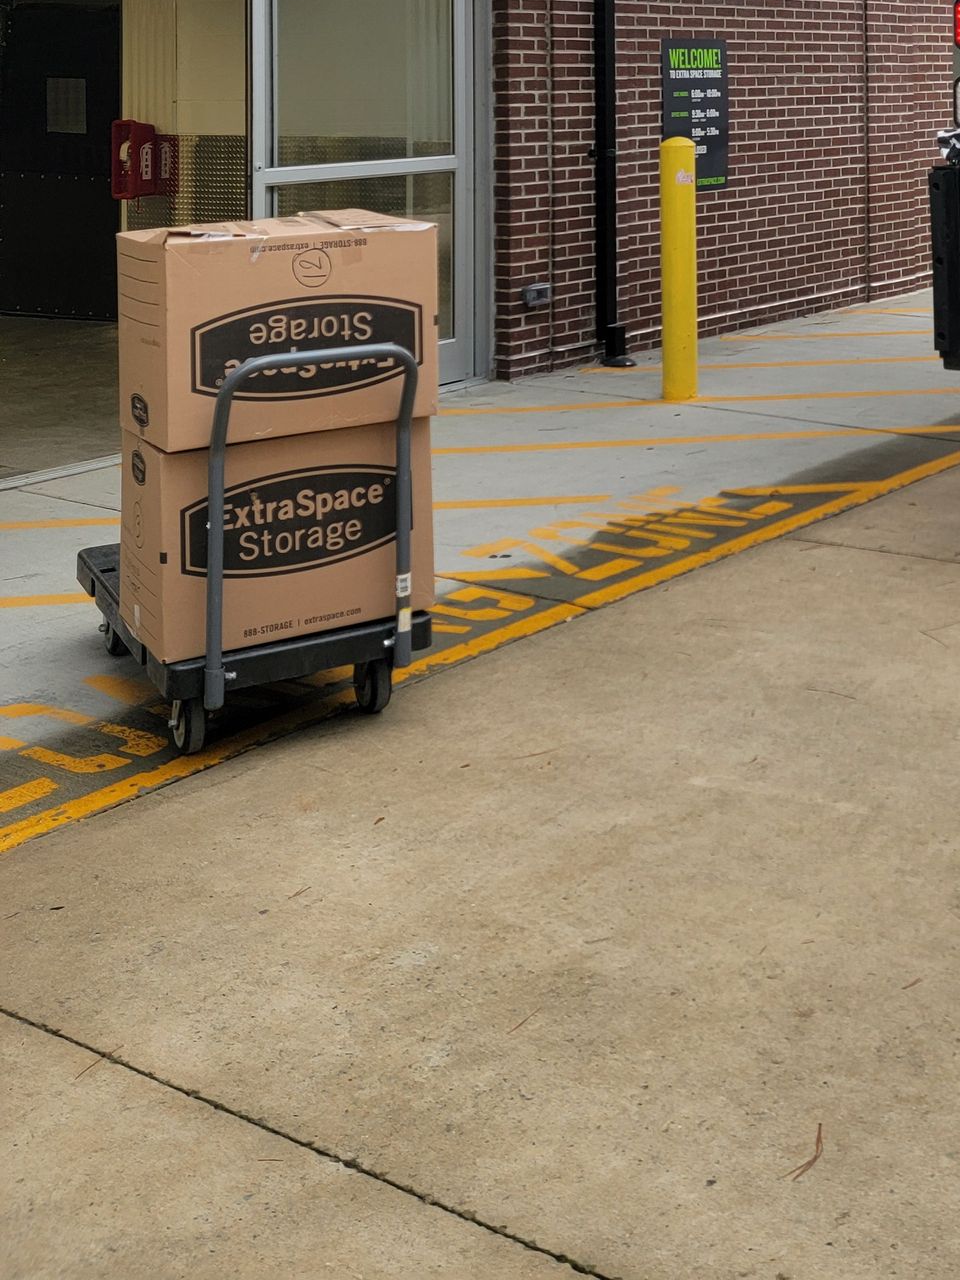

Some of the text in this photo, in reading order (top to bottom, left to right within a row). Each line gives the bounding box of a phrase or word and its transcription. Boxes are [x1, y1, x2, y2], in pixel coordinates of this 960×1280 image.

[669, 48, 721, 69] WELCOME!
[319, 238, 367, 251] 888-STORAGE
[249, 311, 372, 344] Storage
[239, 519, 362, 561] Storage
[243, 606, 361, 638] 888-STORAGE extraspace.com
